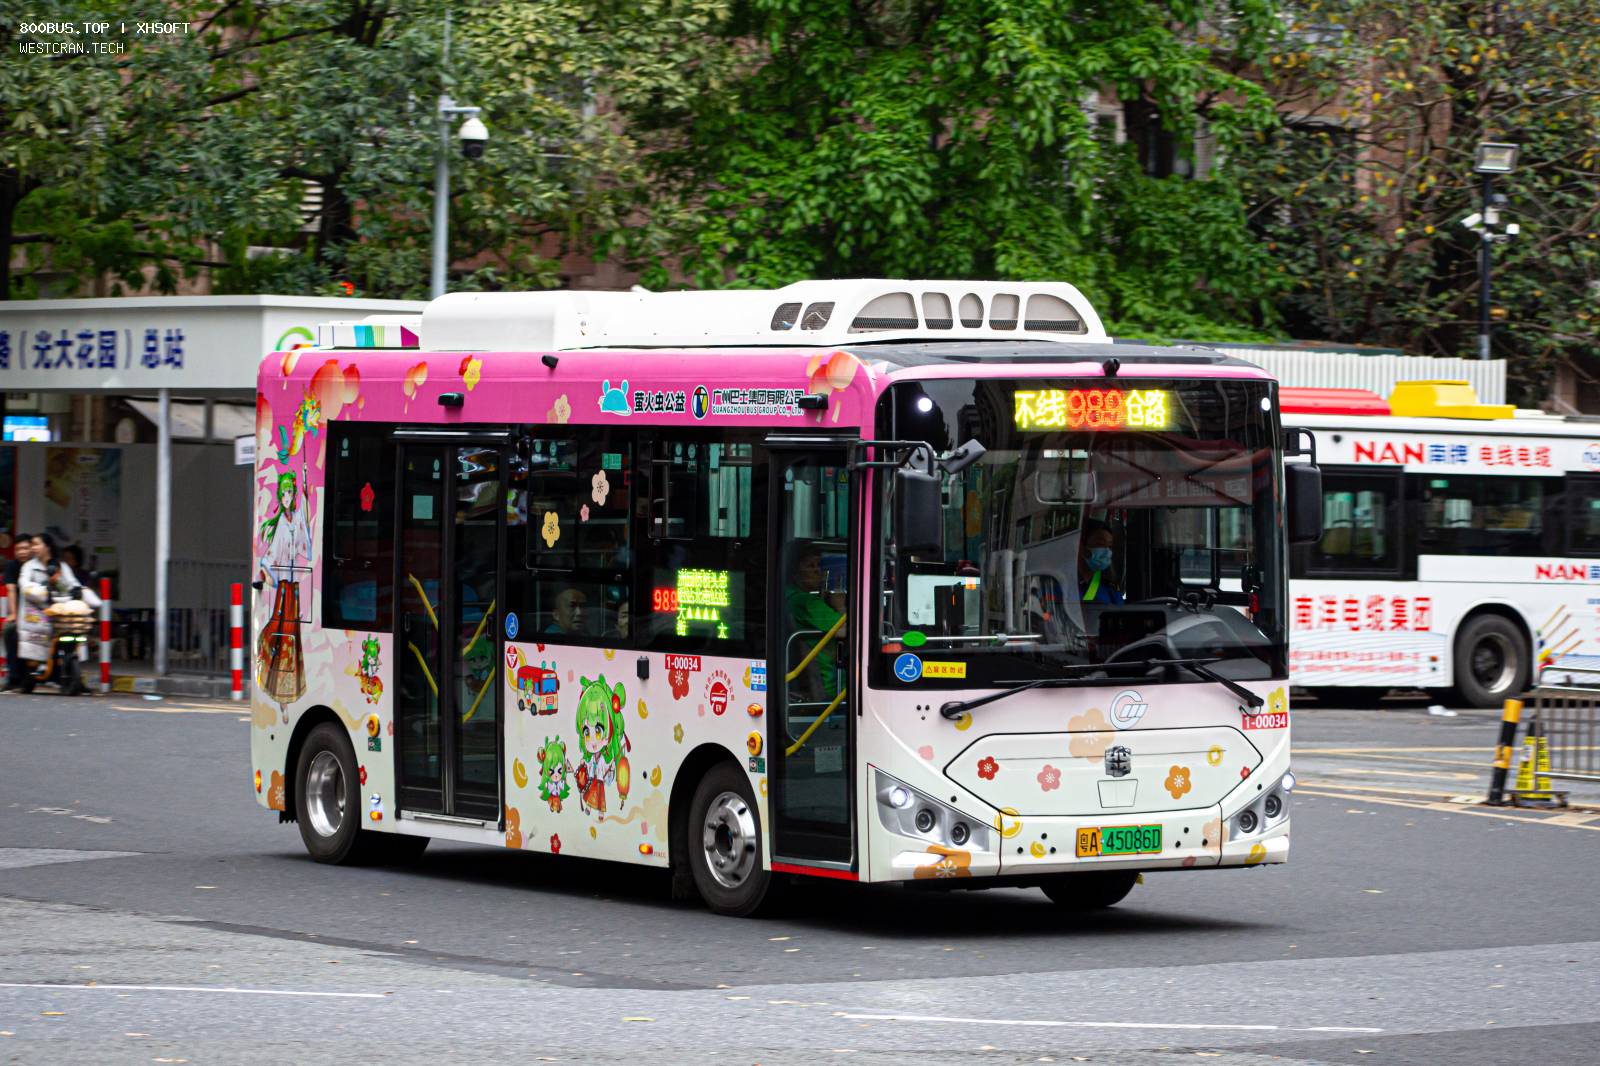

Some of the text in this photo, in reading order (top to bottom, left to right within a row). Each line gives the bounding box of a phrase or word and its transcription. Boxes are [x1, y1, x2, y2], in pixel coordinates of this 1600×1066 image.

[634, 391, 685, 412] 萤火虫公益
[712, 405, 744, 414] GUANGZHOU
[746, 405, 757, 414] BUS
[758, 405, 777, 414] GROUP
[1354, 441, 1424, 464] NAN
[1536, 564, 1586, 580] NAN
[653, 589, 678, 611] 989
[666, 656, 698, 670] 1-00034
[1245, 714, 1286, 729] 1-00034
[1106, 828, 1160, 851] 45086D
